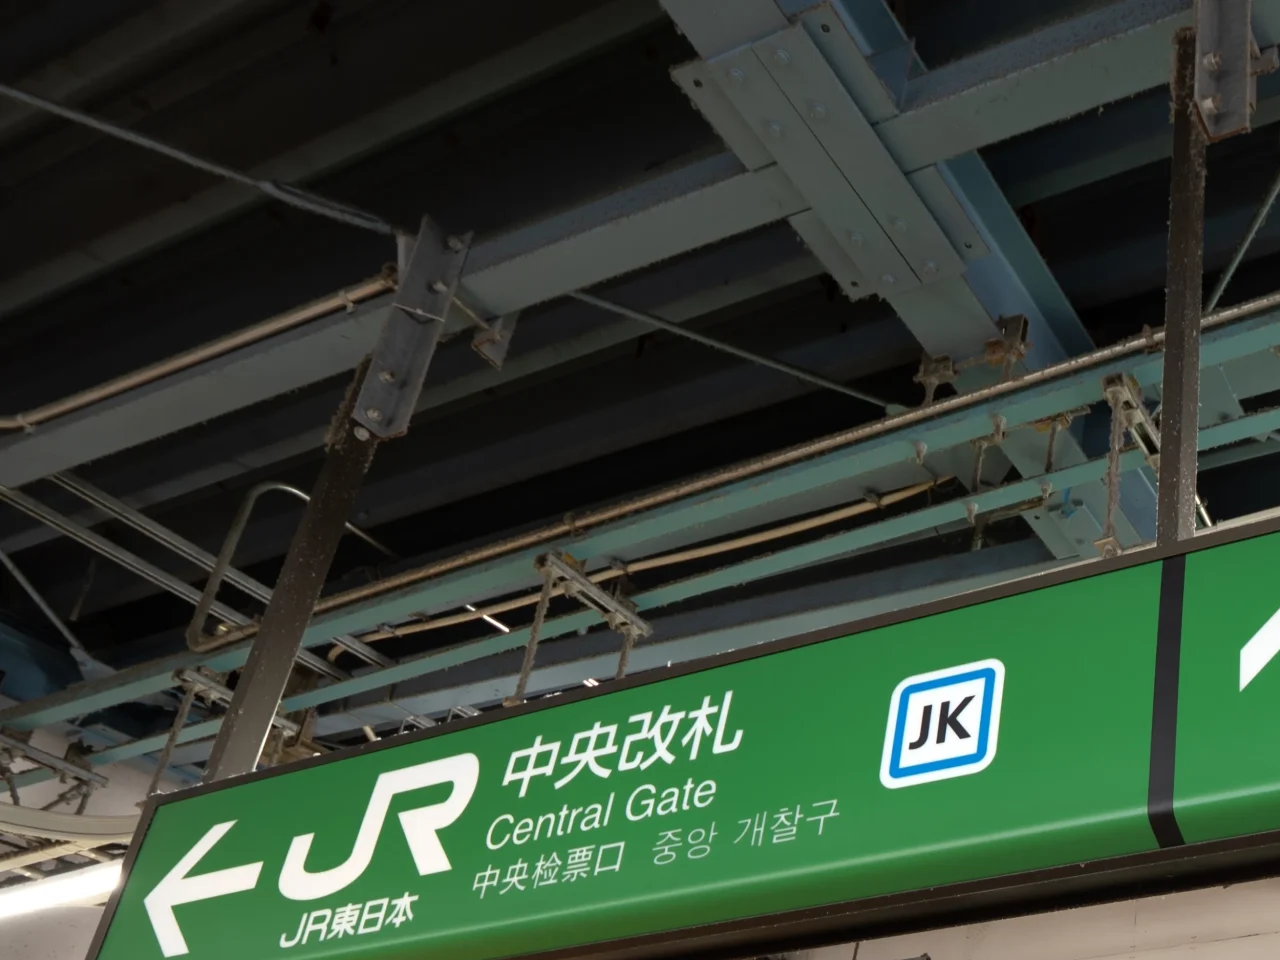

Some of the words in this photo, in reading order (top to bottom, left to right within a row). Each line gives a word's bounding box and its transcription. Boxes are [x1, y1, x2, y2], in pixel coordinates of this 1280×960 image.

[501, 690, 744, 798] 中央改札
[908, 694, 976, 751] JK
[278, 752, 480, 901] JR
[485, 791, 615, 851] Central
[625, 778, 717, 823] Gate
[652, 821, 719, 865] 중앙
[733, 798, 840, 847] 개찰구
[471, 841, 626, 900] 中央检票口
[279, 891, 419, 949] JR東日本
